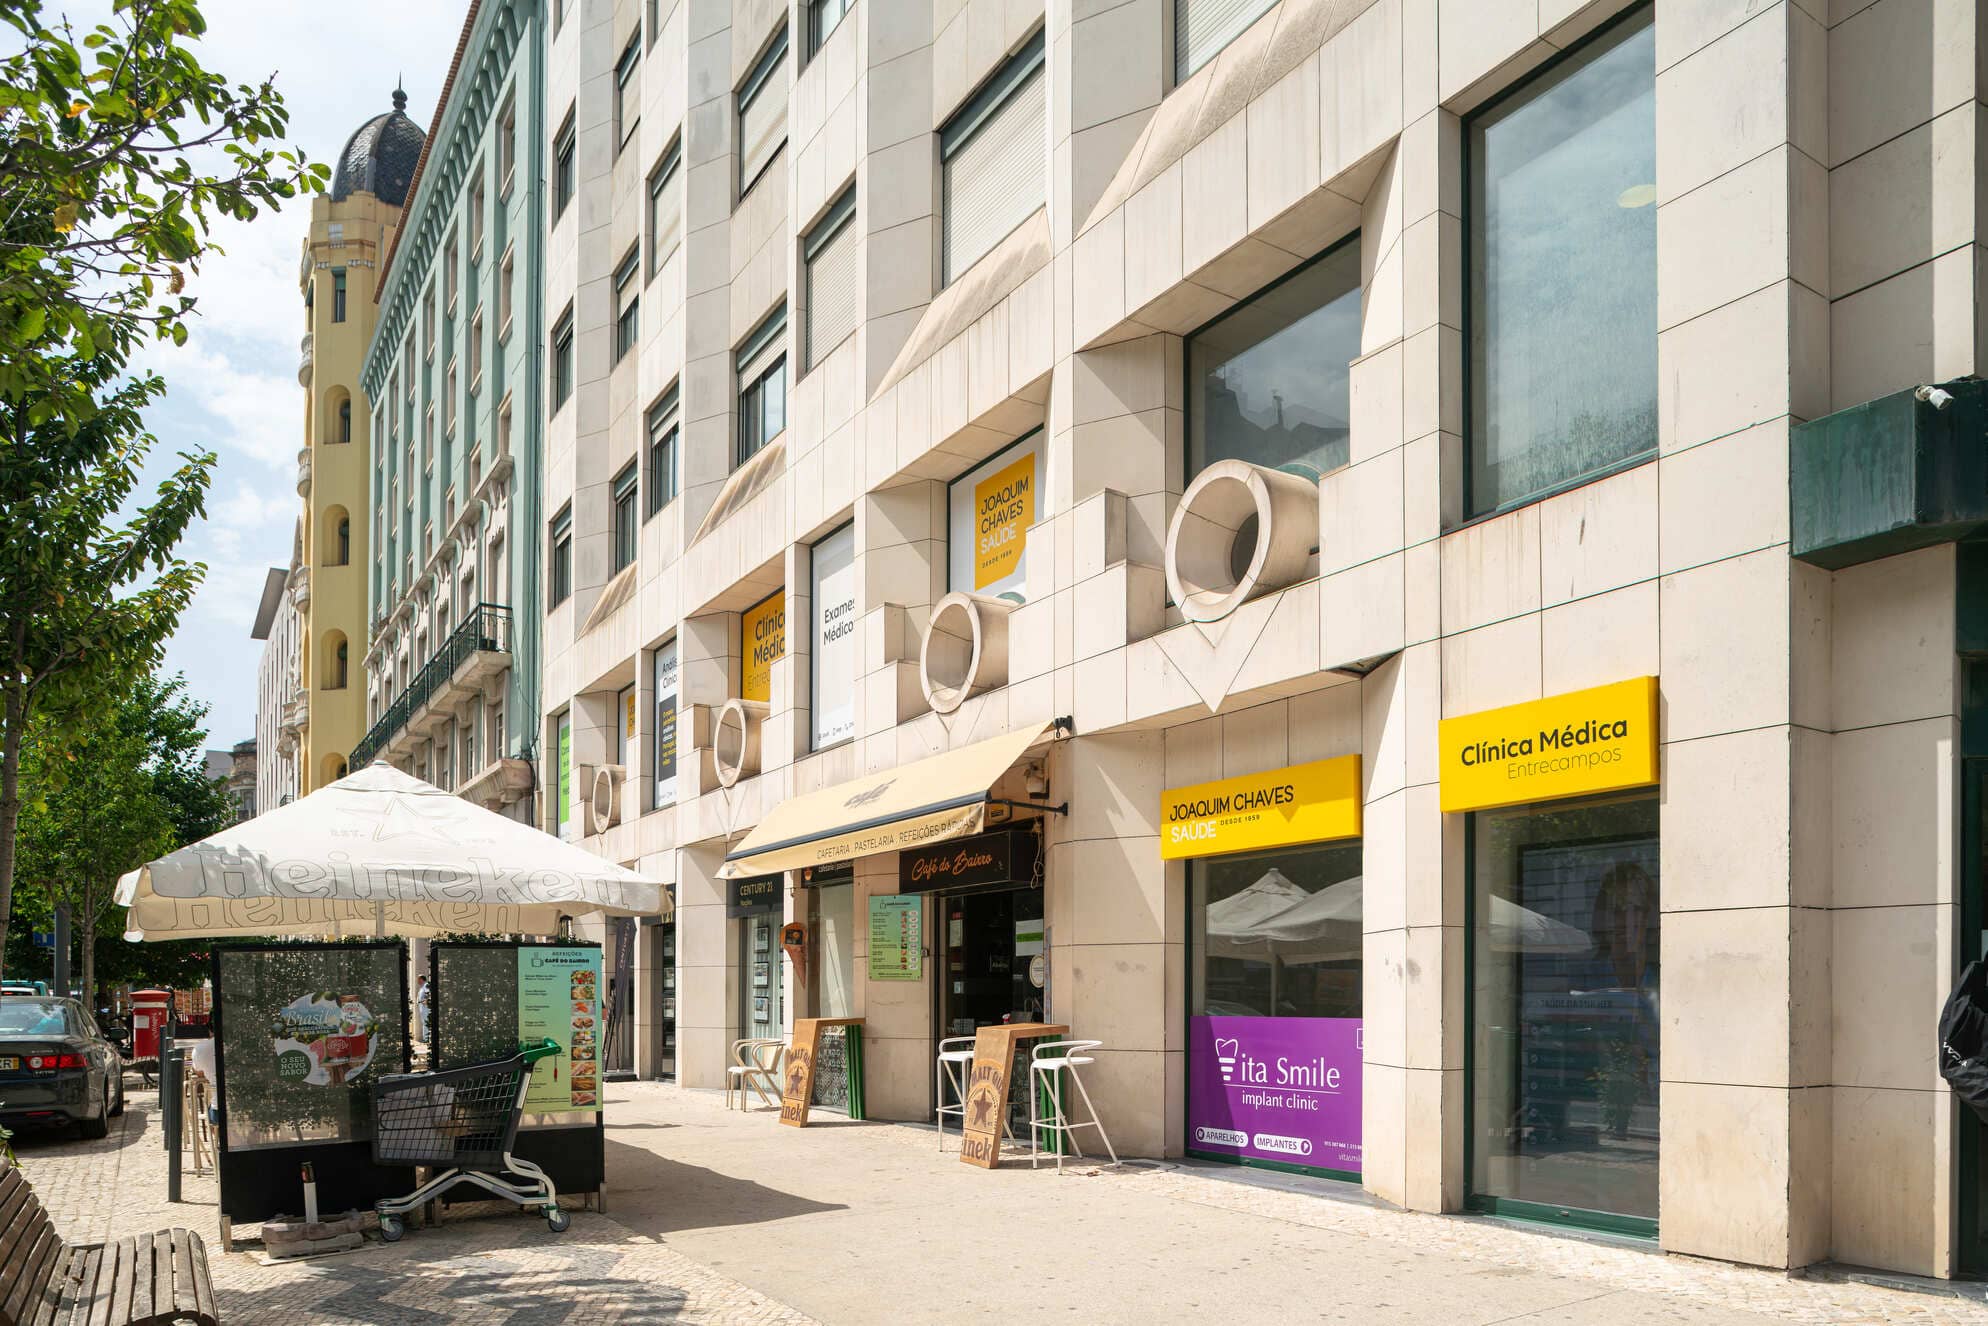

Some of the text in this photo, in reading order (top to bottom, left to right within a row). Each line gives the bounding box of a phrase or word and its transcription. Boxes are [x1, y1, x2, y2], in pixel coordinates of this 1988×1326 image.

[981, 476, 1029, 515] JOAQUIM
[981, 500, 1023, 534] CHAVES
[823, 619, 855, 645] Médico
[1461, 720, 1628, 766] Clínica Médica
[1508, 747, 1622, 779] Entrecampos
[1170, 785, 1294, 821] JOAQUIM CHAVES
[1171, 820, 1217, 843] SAÚDE
[1220, 817, 1242, 826] DESDE
[817, 843, 850, 860] CAFETARIA
[854, 837, 894, 851] PASTELARIA
[911, 849, 993, 881] Café do Bairro
[192, 850, 630, 910] Heineken
[740, 881, 766, 896] CENTURY
[280, 1068, 308, 1076] SABOR
[281, 1062, 306, 1070] NOVO
[1277, 1057, 1340, 1088] Smile
[1242, 1090, 1318, 1111] implant clinic
[961, 1132, 992, 1162] inek
[1205, 1133, 1244, 1144] APARELHOS
[1256, 1137, 1298, 1151] IMPLANTES
